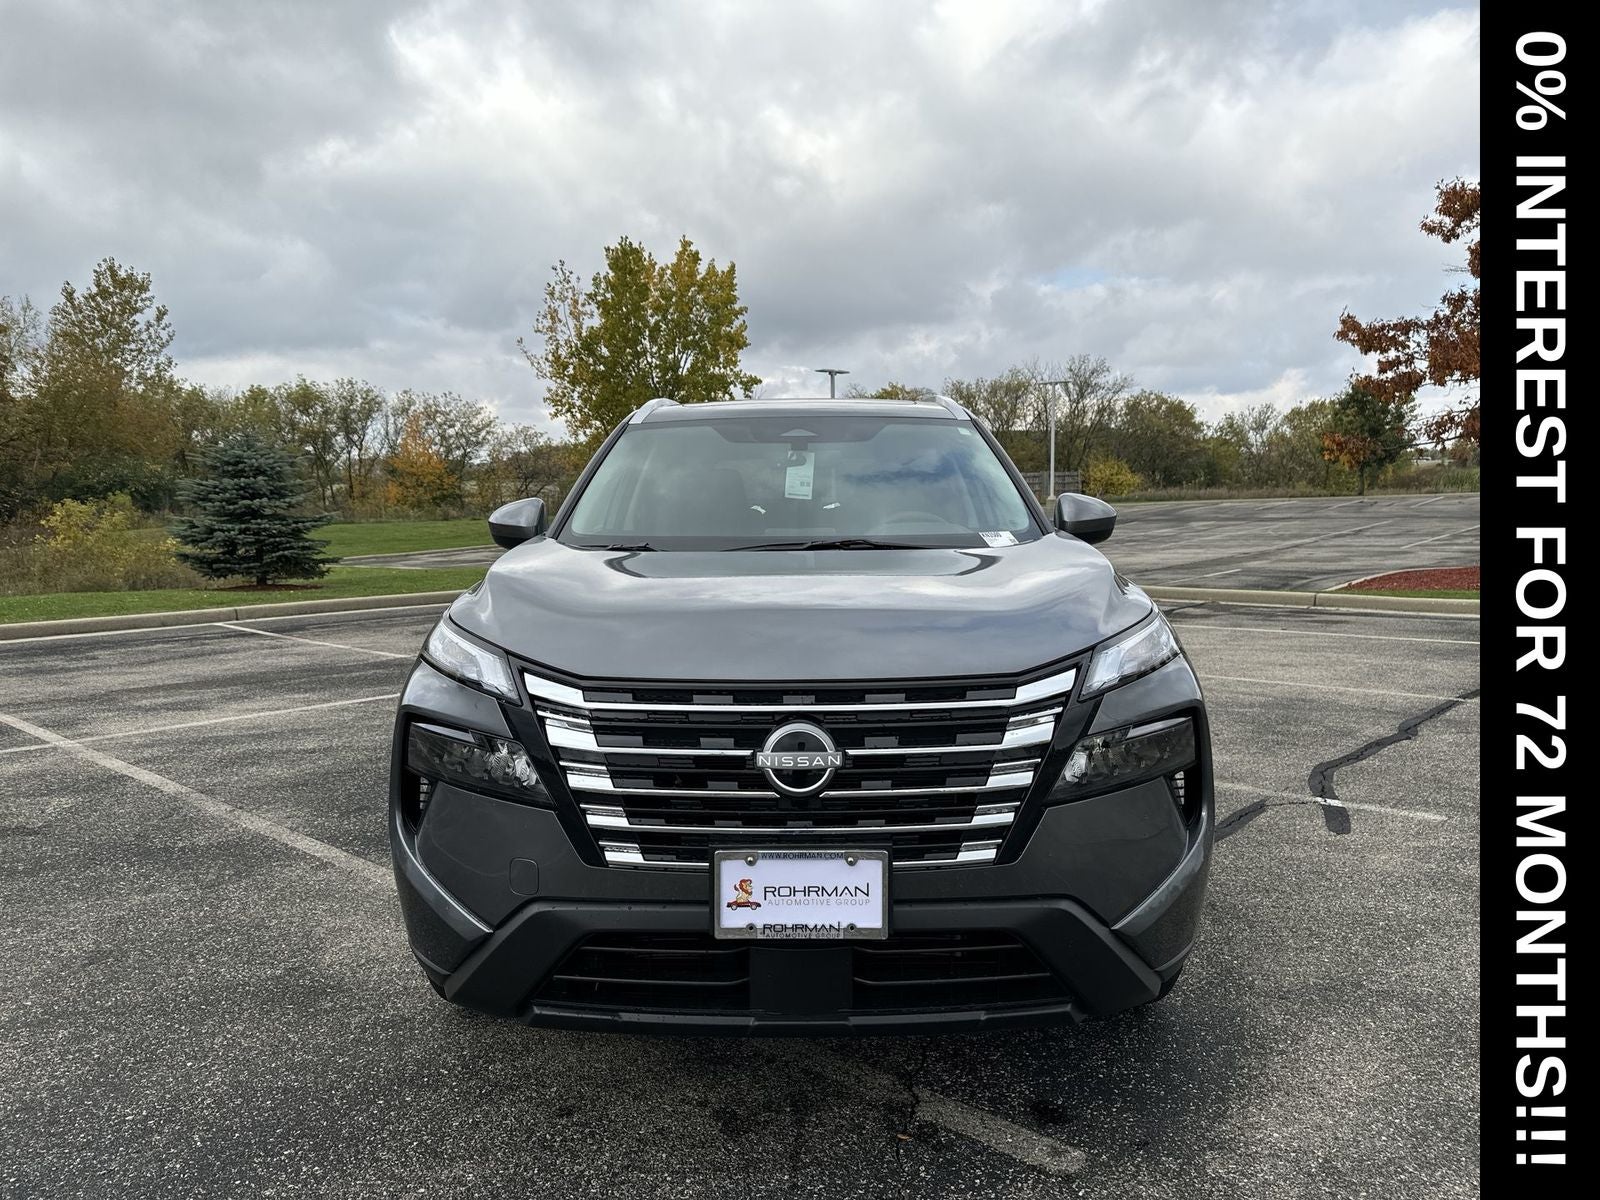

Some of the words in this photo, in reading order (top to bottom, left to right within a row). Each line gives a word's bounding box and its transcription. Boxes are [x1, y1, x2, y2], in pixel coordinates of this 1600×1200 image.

[758, 755, 841, 767] NISSAN
[760, 852, 844, 860] WWW.ROHRMAN.COM
[764, 882, 870, 901] ROHRMAN
[836, 898, 871, 906] GROUP
[762, 921, 841, 935] ROHRMAN
